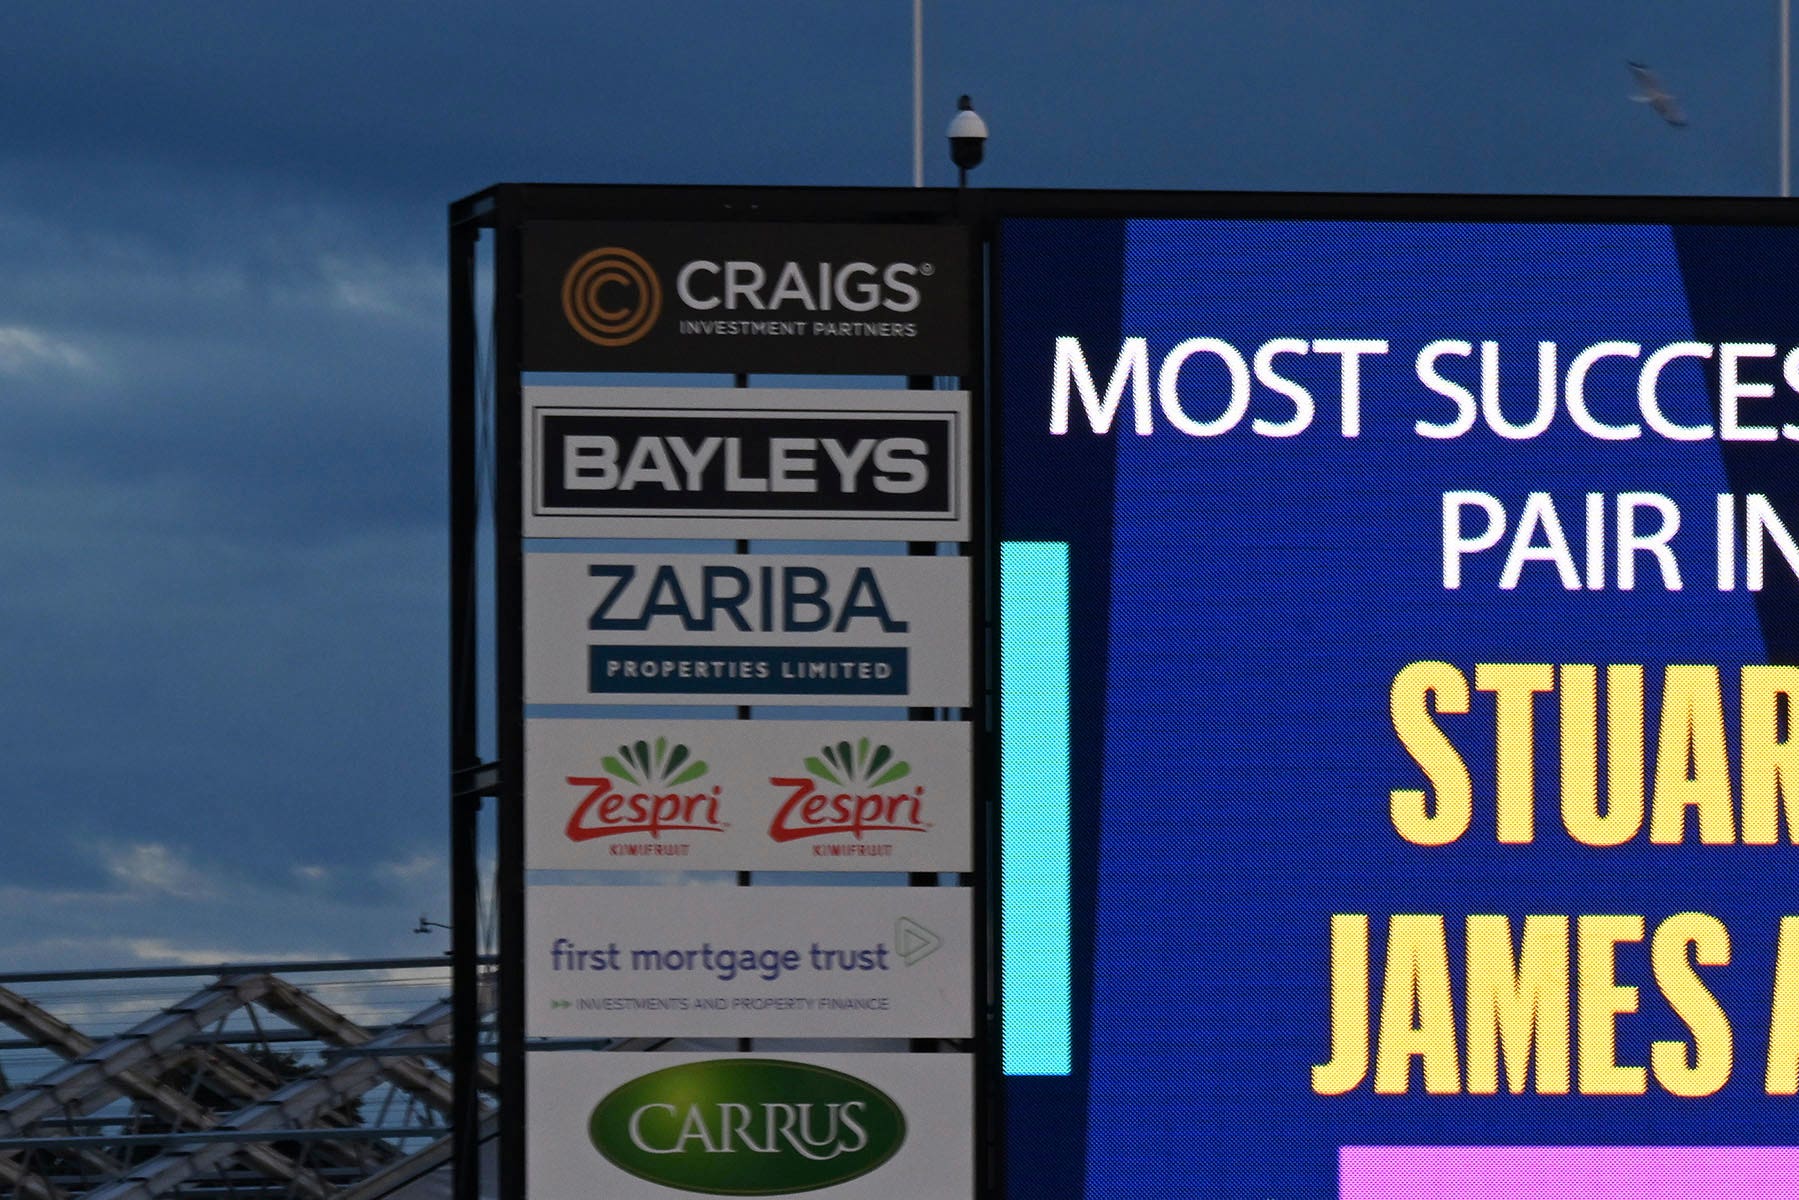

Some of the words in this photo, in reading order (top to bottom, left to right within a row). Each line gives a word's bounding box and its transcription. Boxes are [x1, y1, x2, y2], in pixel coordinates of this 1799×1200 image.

[677, 261, 921, 312] CRAIGS
[680, 321, 806, 335] INVESTMENT
[814, 323, 916, 336] PARTNERS
[1050, 336, 1389, 437] MOST
[564, 435, 928, 493] BAYLEYS
[1443, 490, 1683, 591] PAIR
[588, 565, 908, 633] ZARIBA
[608, 661, 768, 677] PROPERTIES
[782, 663, 890, 678] LIMITED
[566, 774, 723, 842] Zespri
[770, 774, 926, 842] Zespri
[610, 844, 689, 855] KIWIFRUIT
[813, 845, 892, 856] KIWIFRUIT
[551, 939, 620, 970] first
[631, 944, 801, 981] mortgage
[810, 944, 888, 970] trust
[577, 998, 689, 1011] INVESTMENTS
[695, 998, 728, 1009] AND
[733, 998, 813, 1010] PROPERTY
[819, 998, 888, 1010] FINANCE
[1311, 911, 1732, 1096] JAMES
[629, 1098, 866, 1160] CARRUS
